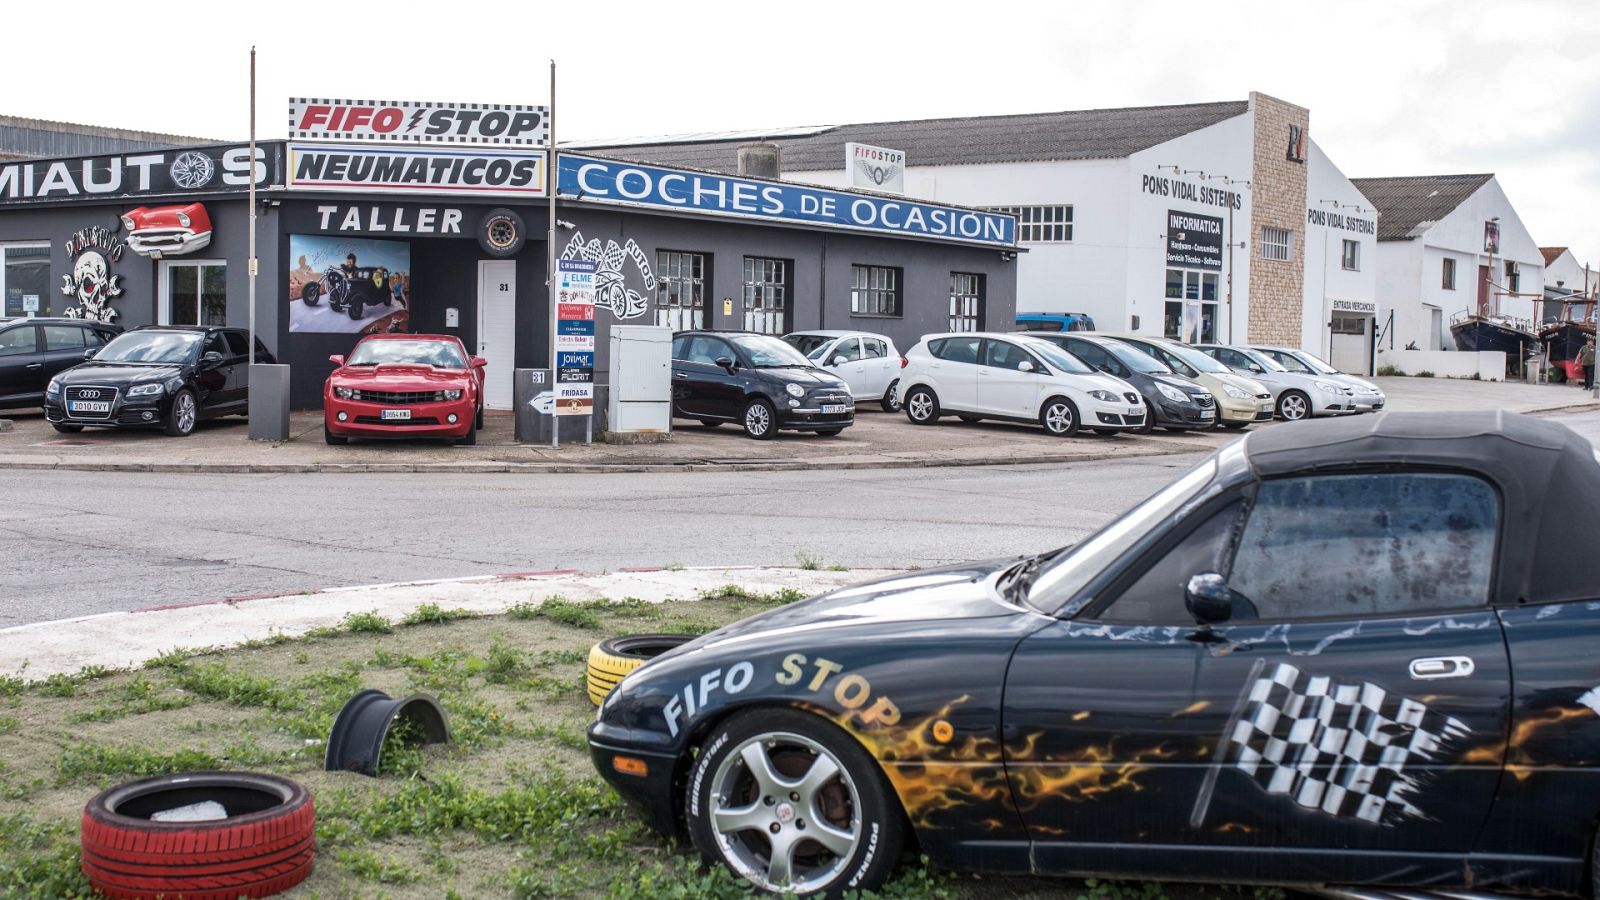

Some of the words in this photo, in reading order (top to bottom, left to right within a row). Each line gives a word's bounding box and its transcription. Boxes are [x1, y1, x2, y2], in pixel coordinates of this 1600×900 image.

[298, 105, 404, 133] FIFO
[424, 109, 541, 137] STOP
[295, 153, 536, 187] NEUMATICOS
[576, 163, 785, 215] COCHES
[799, 194, 837, 217] DE
[850, 199, 1006, 241] OCASIÓN
[1142, 174, 1169, 198] PONS
[1171, 180, 1198, 202] VIDAL
[1200, 186, 1241, 210] SISTEMAS
[317, 205, 463, 234] TALLER
[1170, 214, 1221, 235] INFORMATICA
[1307, 208, 1326, 225] PONS
[1327, 212, 1345, 229] VIDAL
[1346, 216, 1375, 235] SISTEMAS
[561, 233, 584, 260] OMI
[626, 242, 655, 290] AUTOS
[500, 283, 509, 292] 31
[571, 273, 592, 283] ELME
[533, 373, 543, 383] 31
[561, 389, 589, 397] FRIDASA
[662, 661, 754, 738] FIFO
[775, 653, 901, 726] STOP
[691, 732, 730, 817] BRIDGESTONE
[849, 822, 880, 888] POTENZA
